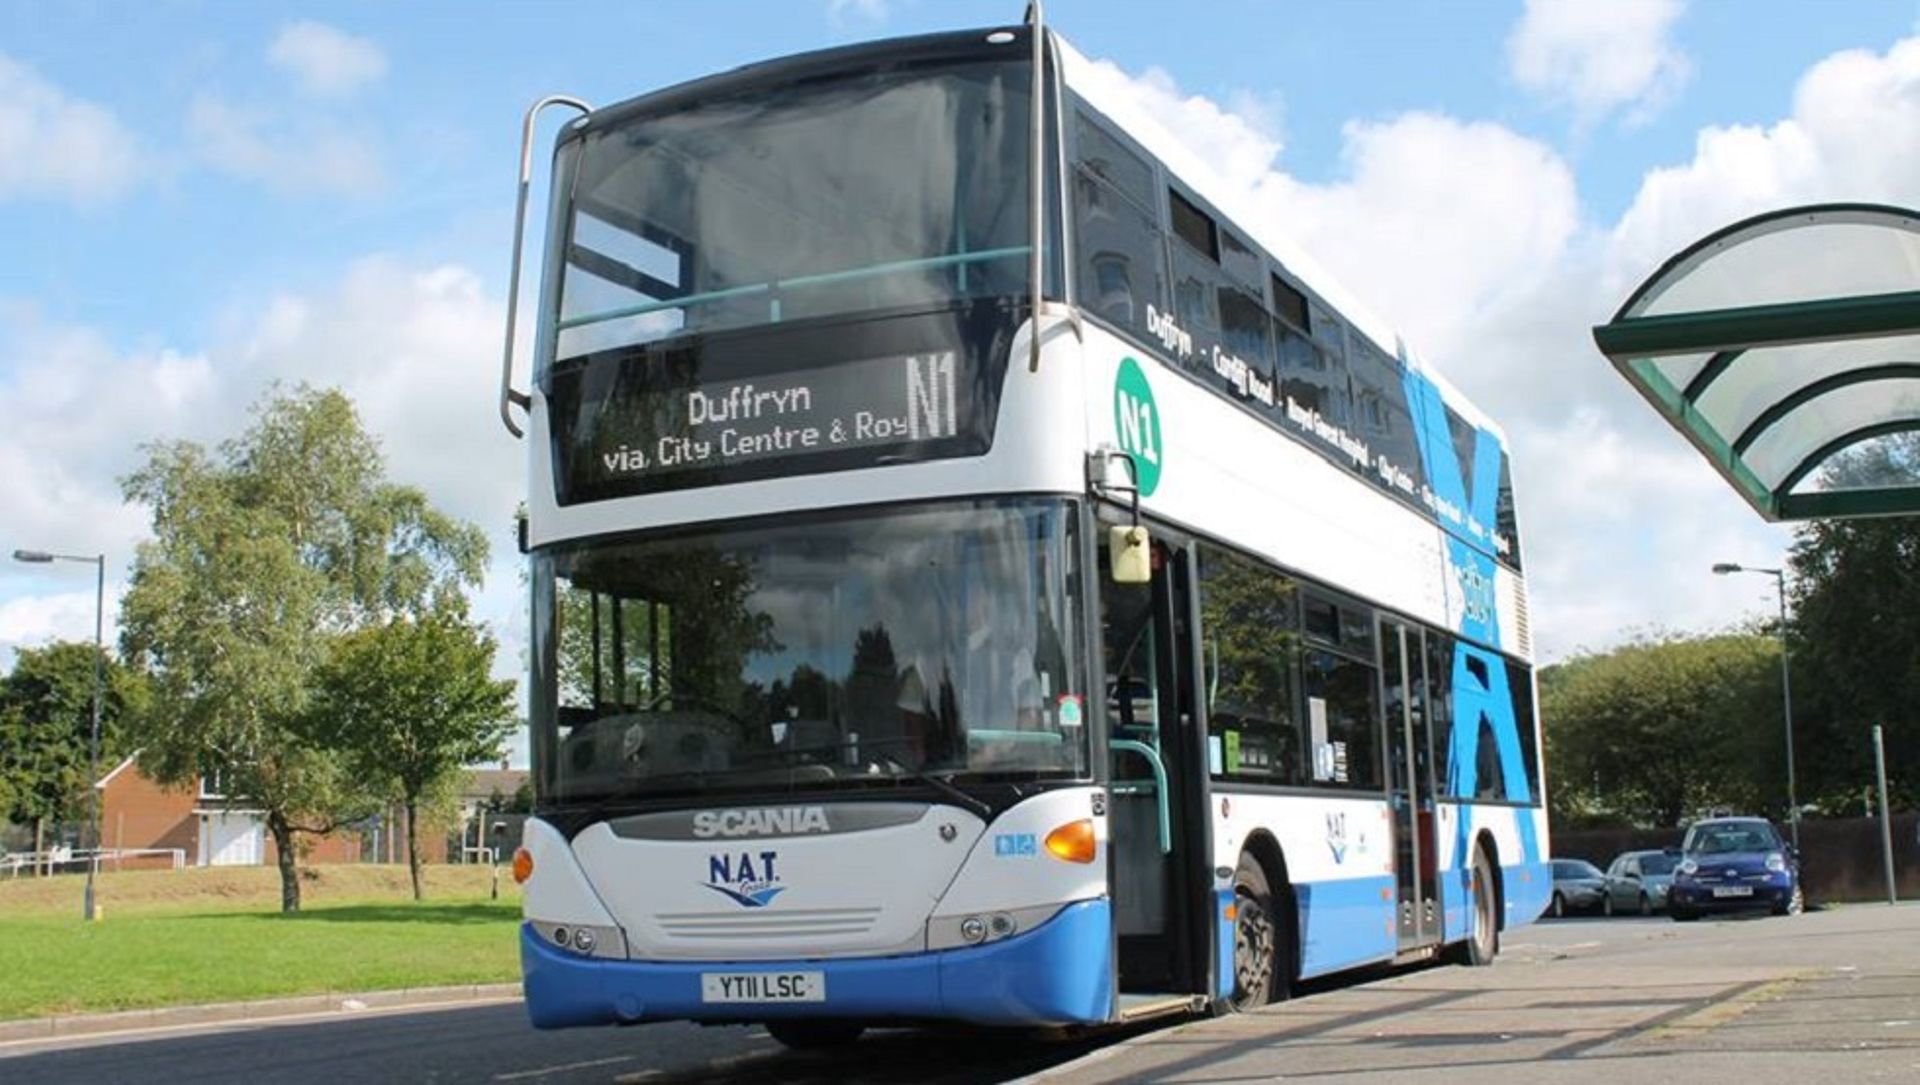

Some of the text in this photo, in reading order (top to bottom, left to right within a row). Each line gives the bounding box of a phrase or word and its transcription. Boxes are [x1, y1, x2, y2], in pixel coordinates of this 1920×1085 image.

[1146, 303, 1191, 356] Duffryn
[688, 384, 811, 425] Duffryn
[905, 351, 957, 440] N1
[658, 436, 711, 466] City
[721, 425, 820, 456] Centre
[829, 417, 848, 443] &
[855, 411, 907, 440] Roy
[1118, 389, 1157, 465] N1
[693, 806, 830, 838] SCANIA
[720, 975, 805, 998] YT11 LSC
